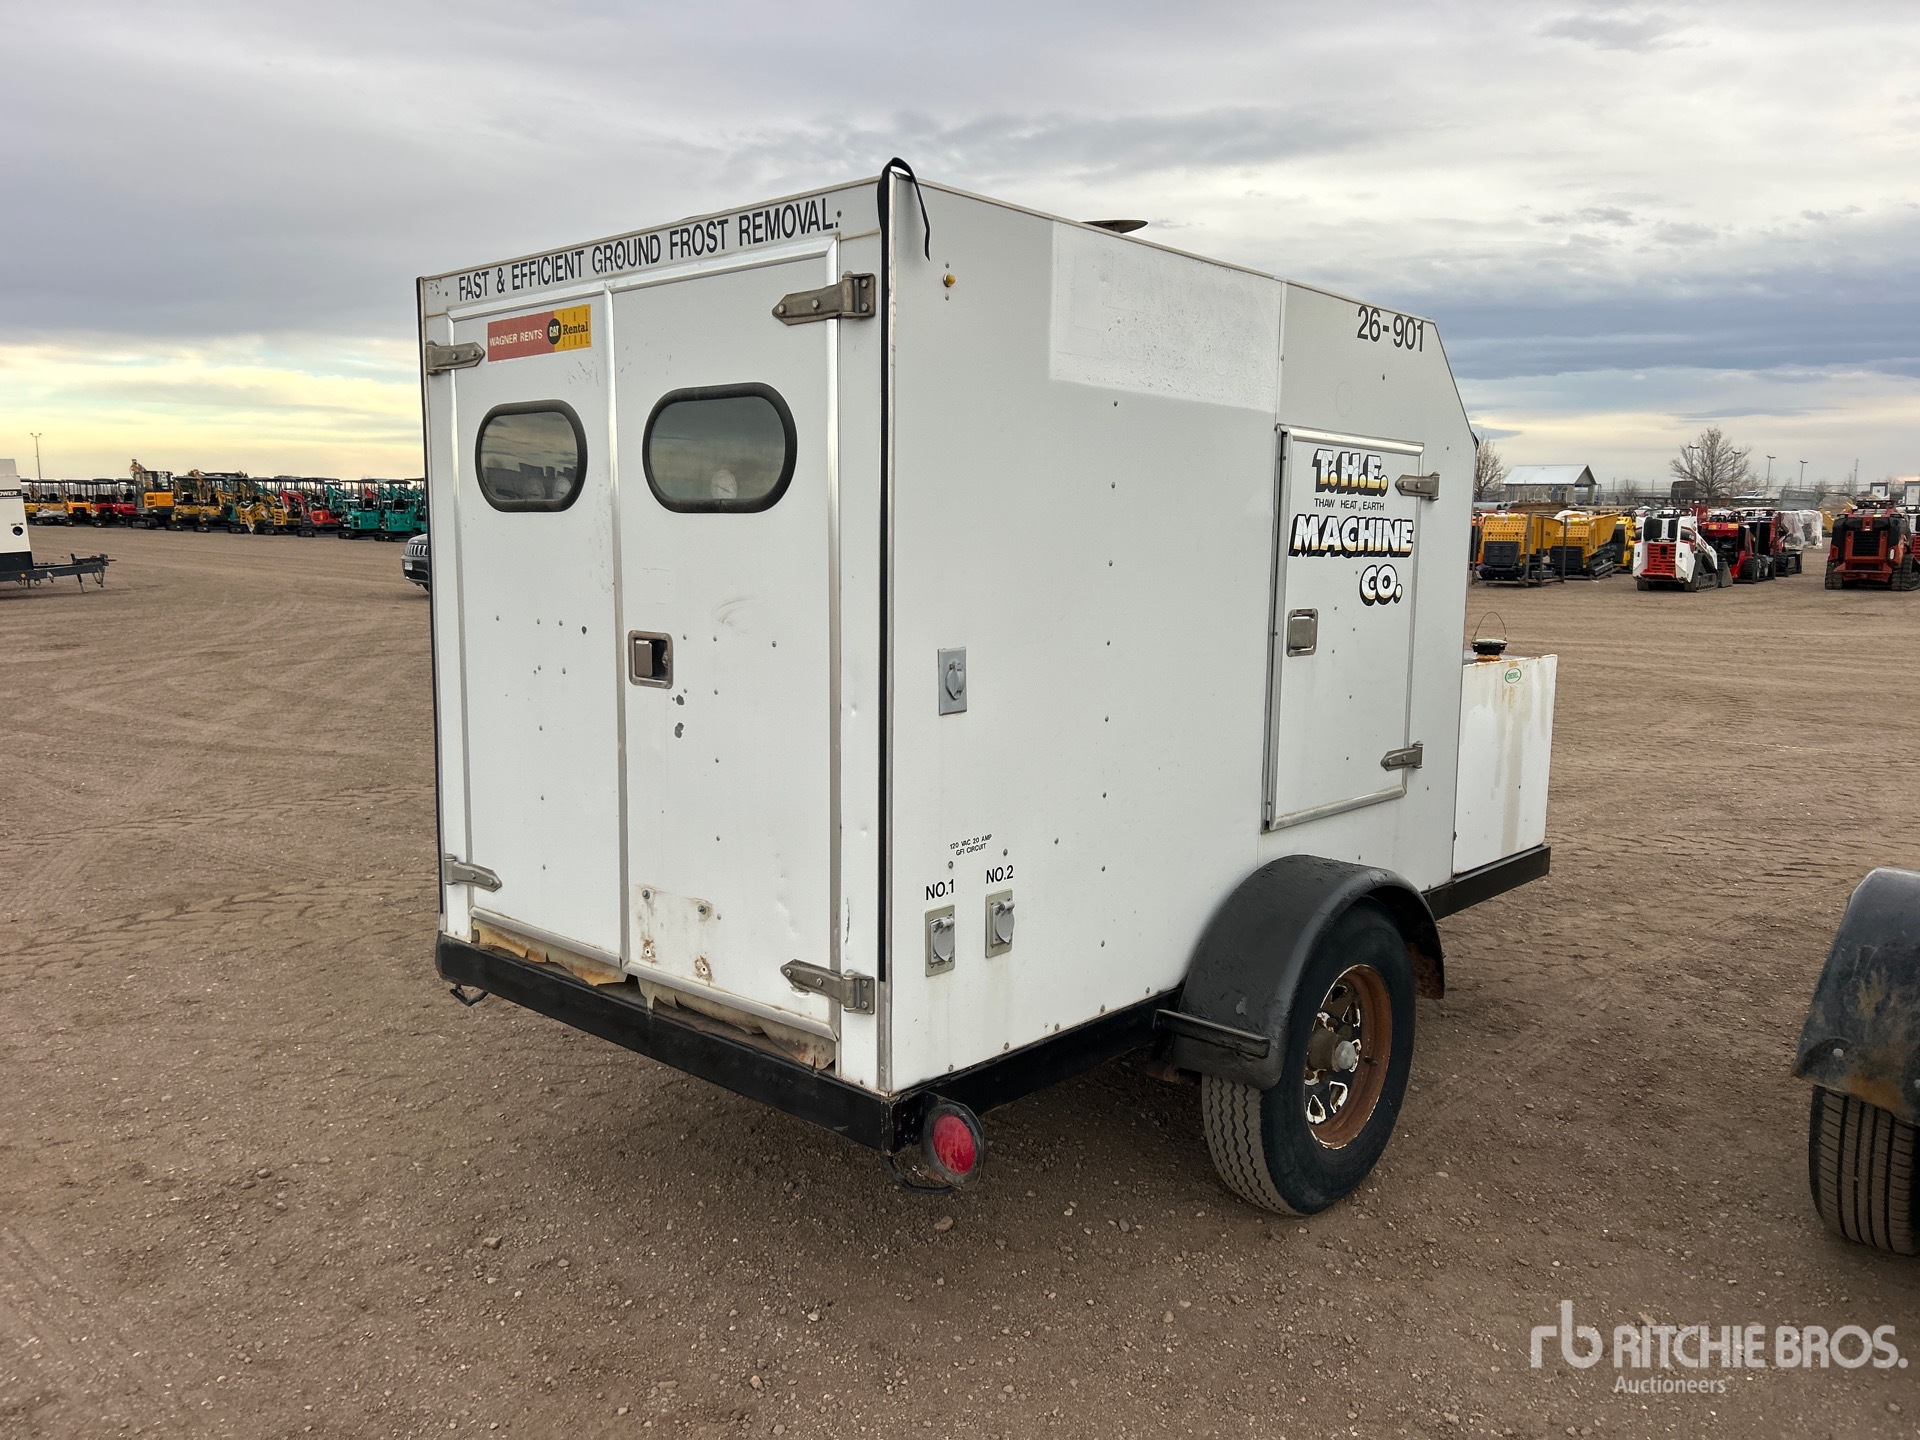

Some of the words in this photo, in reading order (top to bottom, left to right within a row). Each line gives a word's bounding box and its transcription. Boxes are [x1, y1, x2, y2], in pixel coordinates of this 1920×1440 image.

[458, 266, 490, 301] FAST
[497, 266, 506, 293] &
[511, 249, 585, 289] EFFICIENT
[592, 234, 661, 274] GROUND
[669, 218, 729, 260] FROST
[489, 333, 518, 347] WAGNER
[520, 329, 543, 343] RENTS
[549, 325, 559, 338] CAT
[562, 321, 588, 336] Rental
[1357, 305, 1424, 352] 26-901
[1314, 498, 1335, 508] THAW
[1362, 501, 1385, 511] EARTH
[1288, 513, 1414, 558] MACHINE
[1359, 564, 1403, 606] CO.
[986, 865, 1014, 884] NO.2
[926, 879, 954, 900] NO.1
